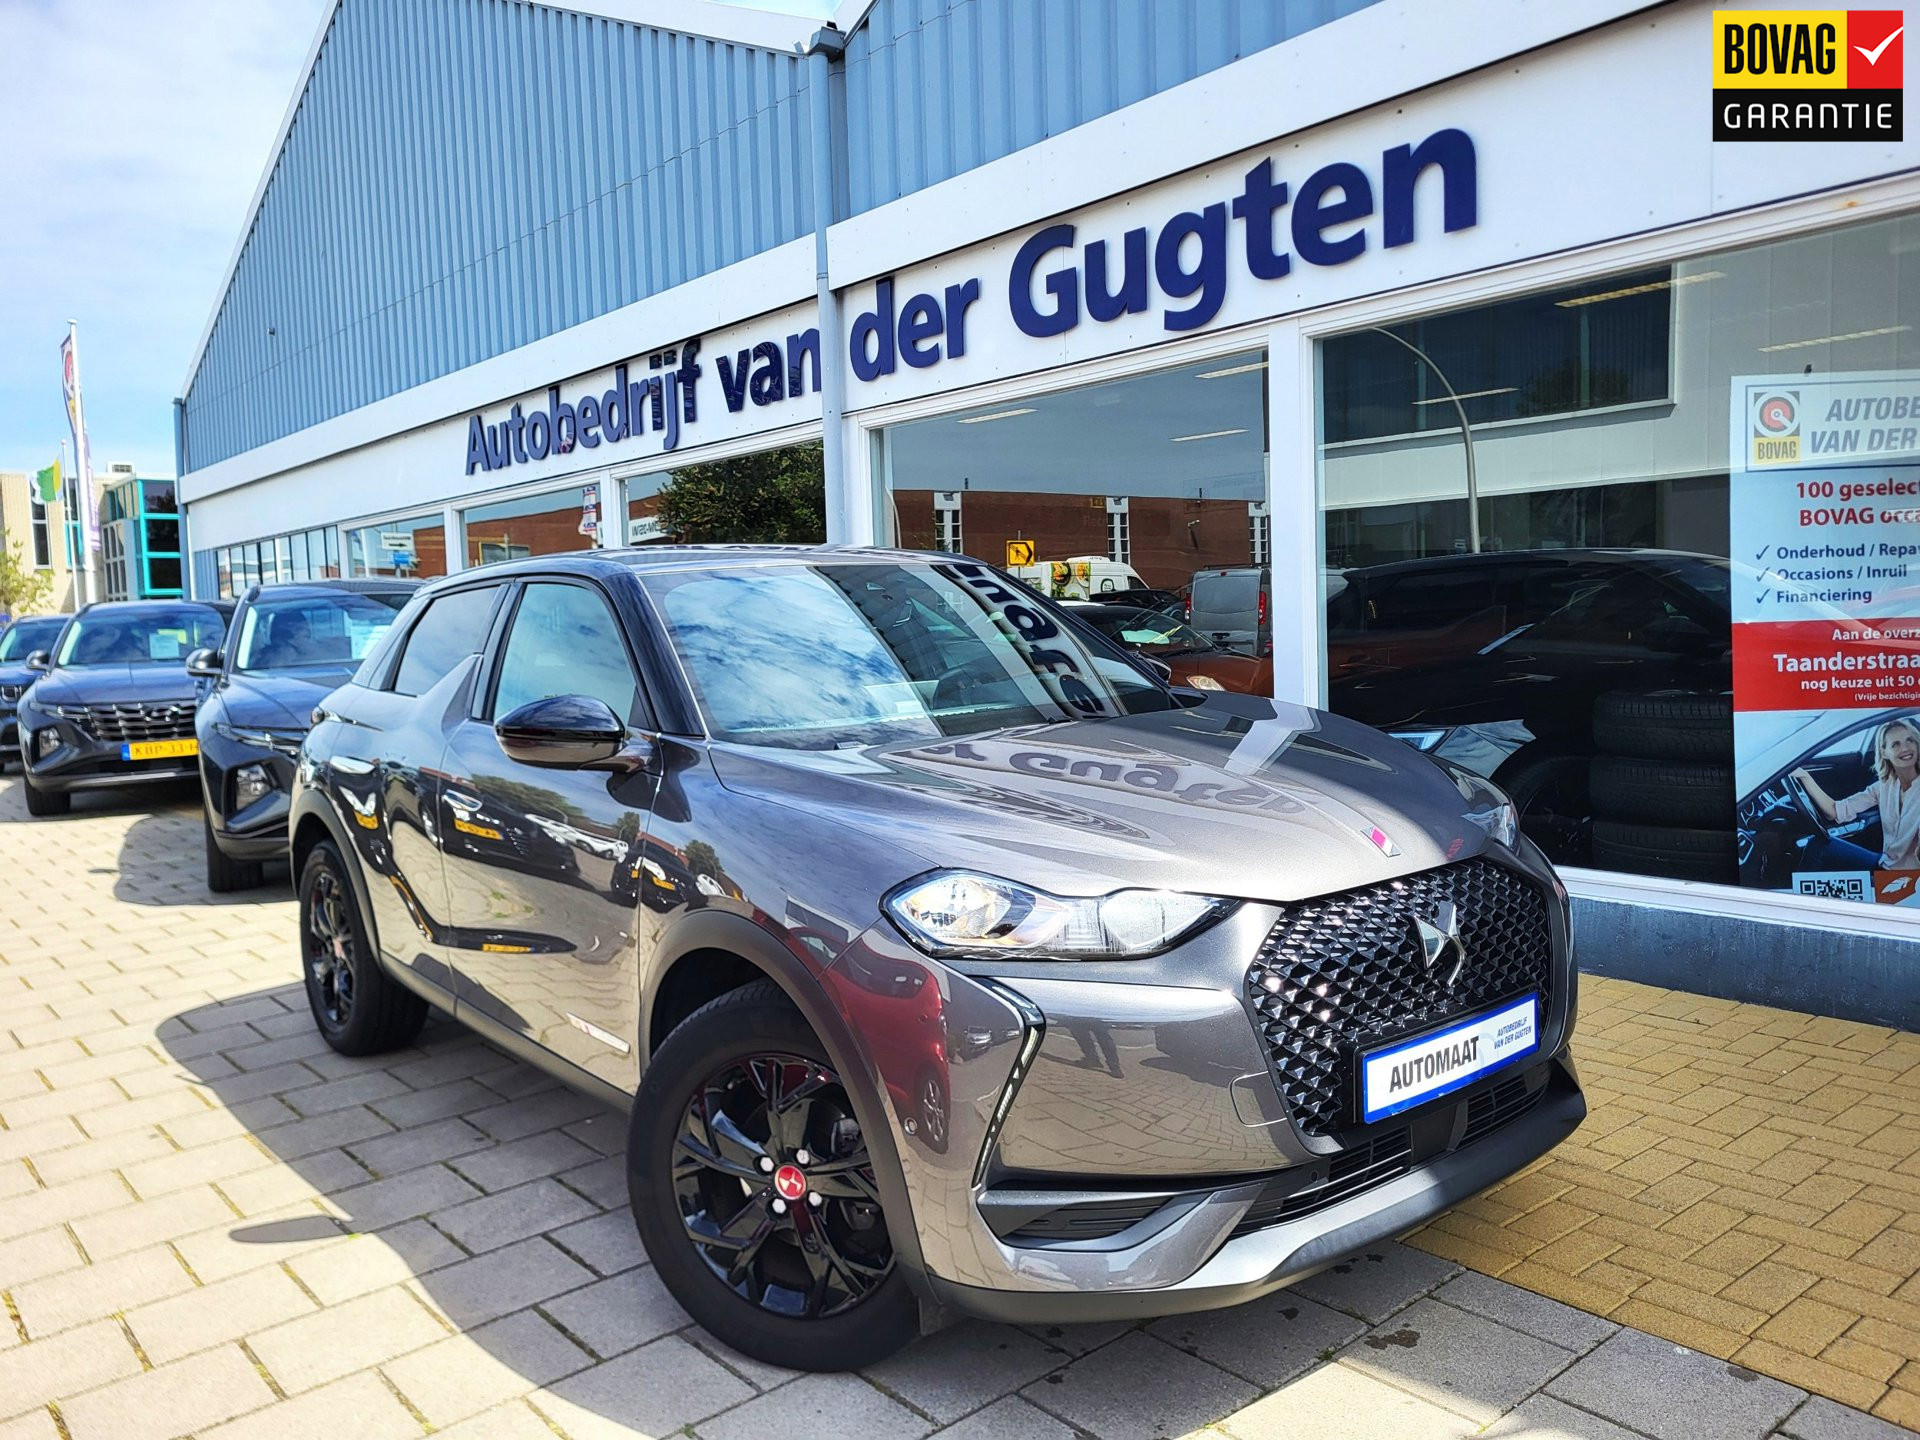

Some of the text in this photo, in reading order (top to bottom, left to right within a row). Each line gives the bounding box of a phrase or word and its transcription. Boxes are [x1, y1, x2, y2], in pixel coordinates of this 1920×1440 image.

[466, 128, 1477, 475] Autobedrijf van der Gugten
[1811, 427, 1918, 453] VAN DER
[1758, 441, 1796, 459] BOVAG
[1797, 478, 1920, 501] 100 geselec
[1800, 507, 1874, 526] BOVAG
[1777, 544, 1865, 558] Onderhoud
[1778, 569, 1853, 581] Occasions
[1867, 565, 1907, 578] Inruil
[1777, 588, 1872, 603] Financiering
[1832, 628, 1859, 640] Aan
[1863, 627, 1880, 639] de
[1801, 675, 1914, 692] nog keuze uit 50
[1389, 1036, 1480, 1093] AUTOMAAT
